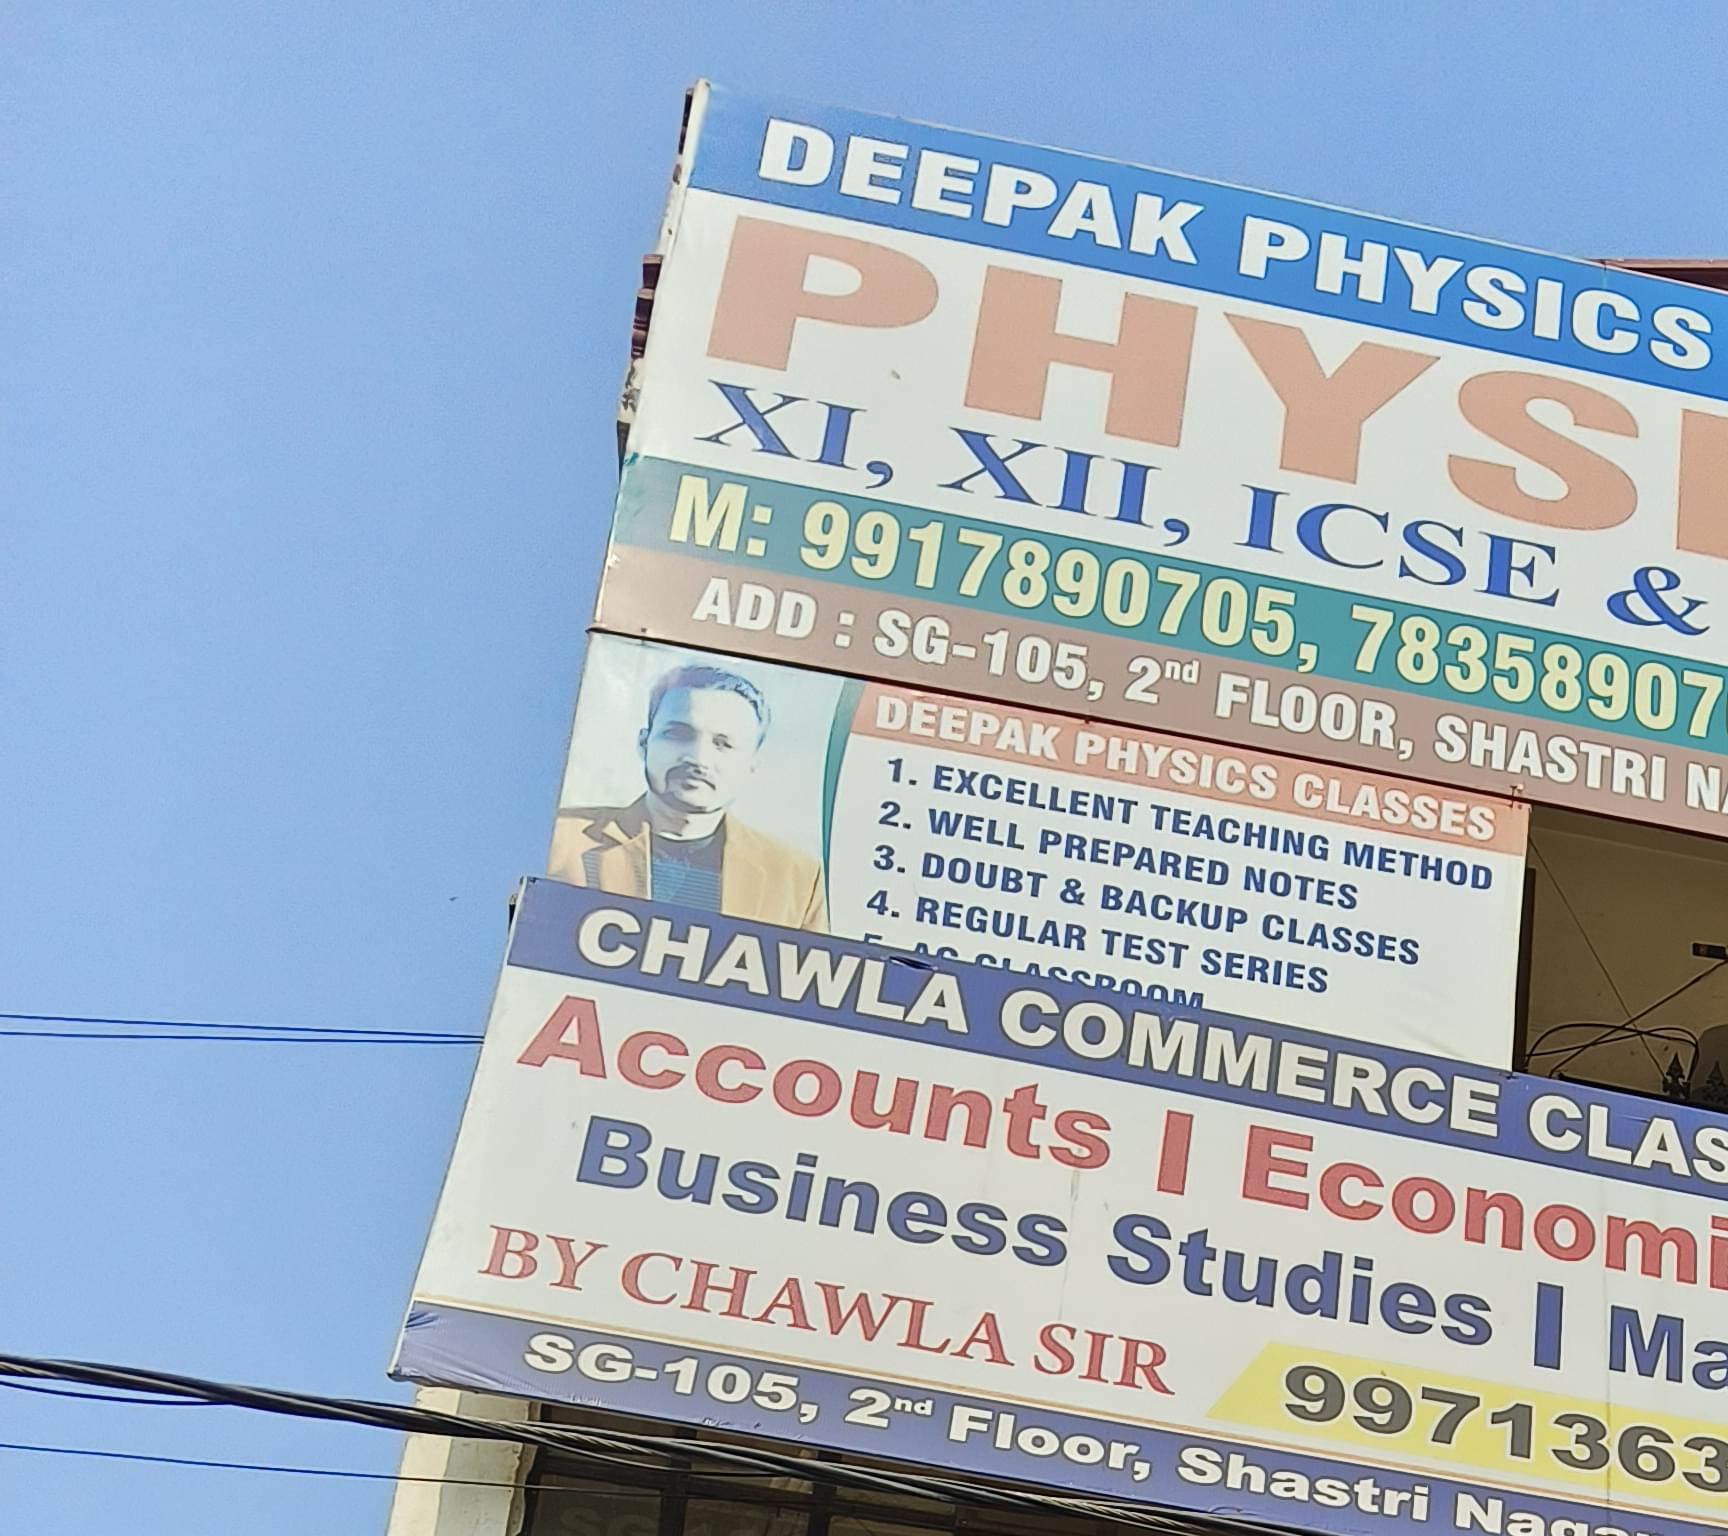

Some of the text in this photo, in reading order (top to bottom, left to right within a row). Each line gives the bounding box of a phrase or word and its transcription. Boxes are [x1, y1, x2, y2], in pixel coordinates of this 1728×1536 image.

[758, 117, 1205, 267] DEEPAK
[1239, 216, 1713, 370] PHYSICS
[695, 379, 893, 488] XI,
[939, 426, 1189, 546] XII,
[1234, 483, 1561, 608] ICSE
[1606, 566, 1711, 636] &
[802, 502, 1319, 674] 9917890705,
[692, 577, 817, 639] ADD
[873, 609, 1104, 701] SG-105,
[1215, 672, 1413, 760] FLOOR,
[1433, 714, 1667, 802] SHASTRI
[875, 695, 1496, 842] DEEPAK PHYSICS CLASSES
[921, 852, 1420, 965] DOUBT BACKUP CLASSES
[928, 808, 1359, 910] WELL PREPARED NOTES
[932, 765, 1494, 891] EXCELLENT TEACHING METHOD
[575, 907, 971, 1035] CHAWLA
[999, 989, 1501, 1138] COMMERCE
[915, 896, 1088, 952] REGULAR
[1101, 929, 1190, 969] TEST
[1202, 950, 1328, 993] SERIES
[516, 994, 1111, 1169] Accounts
[478, 1225, 1177, 1395] BY CHAWLA SIR
[575, 1114, 1069, 1267] Business
[1107, 1212, 1493, 1347] Studies
[522, 1333, 819, 1425] SG-105,
[947, 1404, 1152, 1481] Floor,
[1176, 1446, 1429, 1521] Shastri
